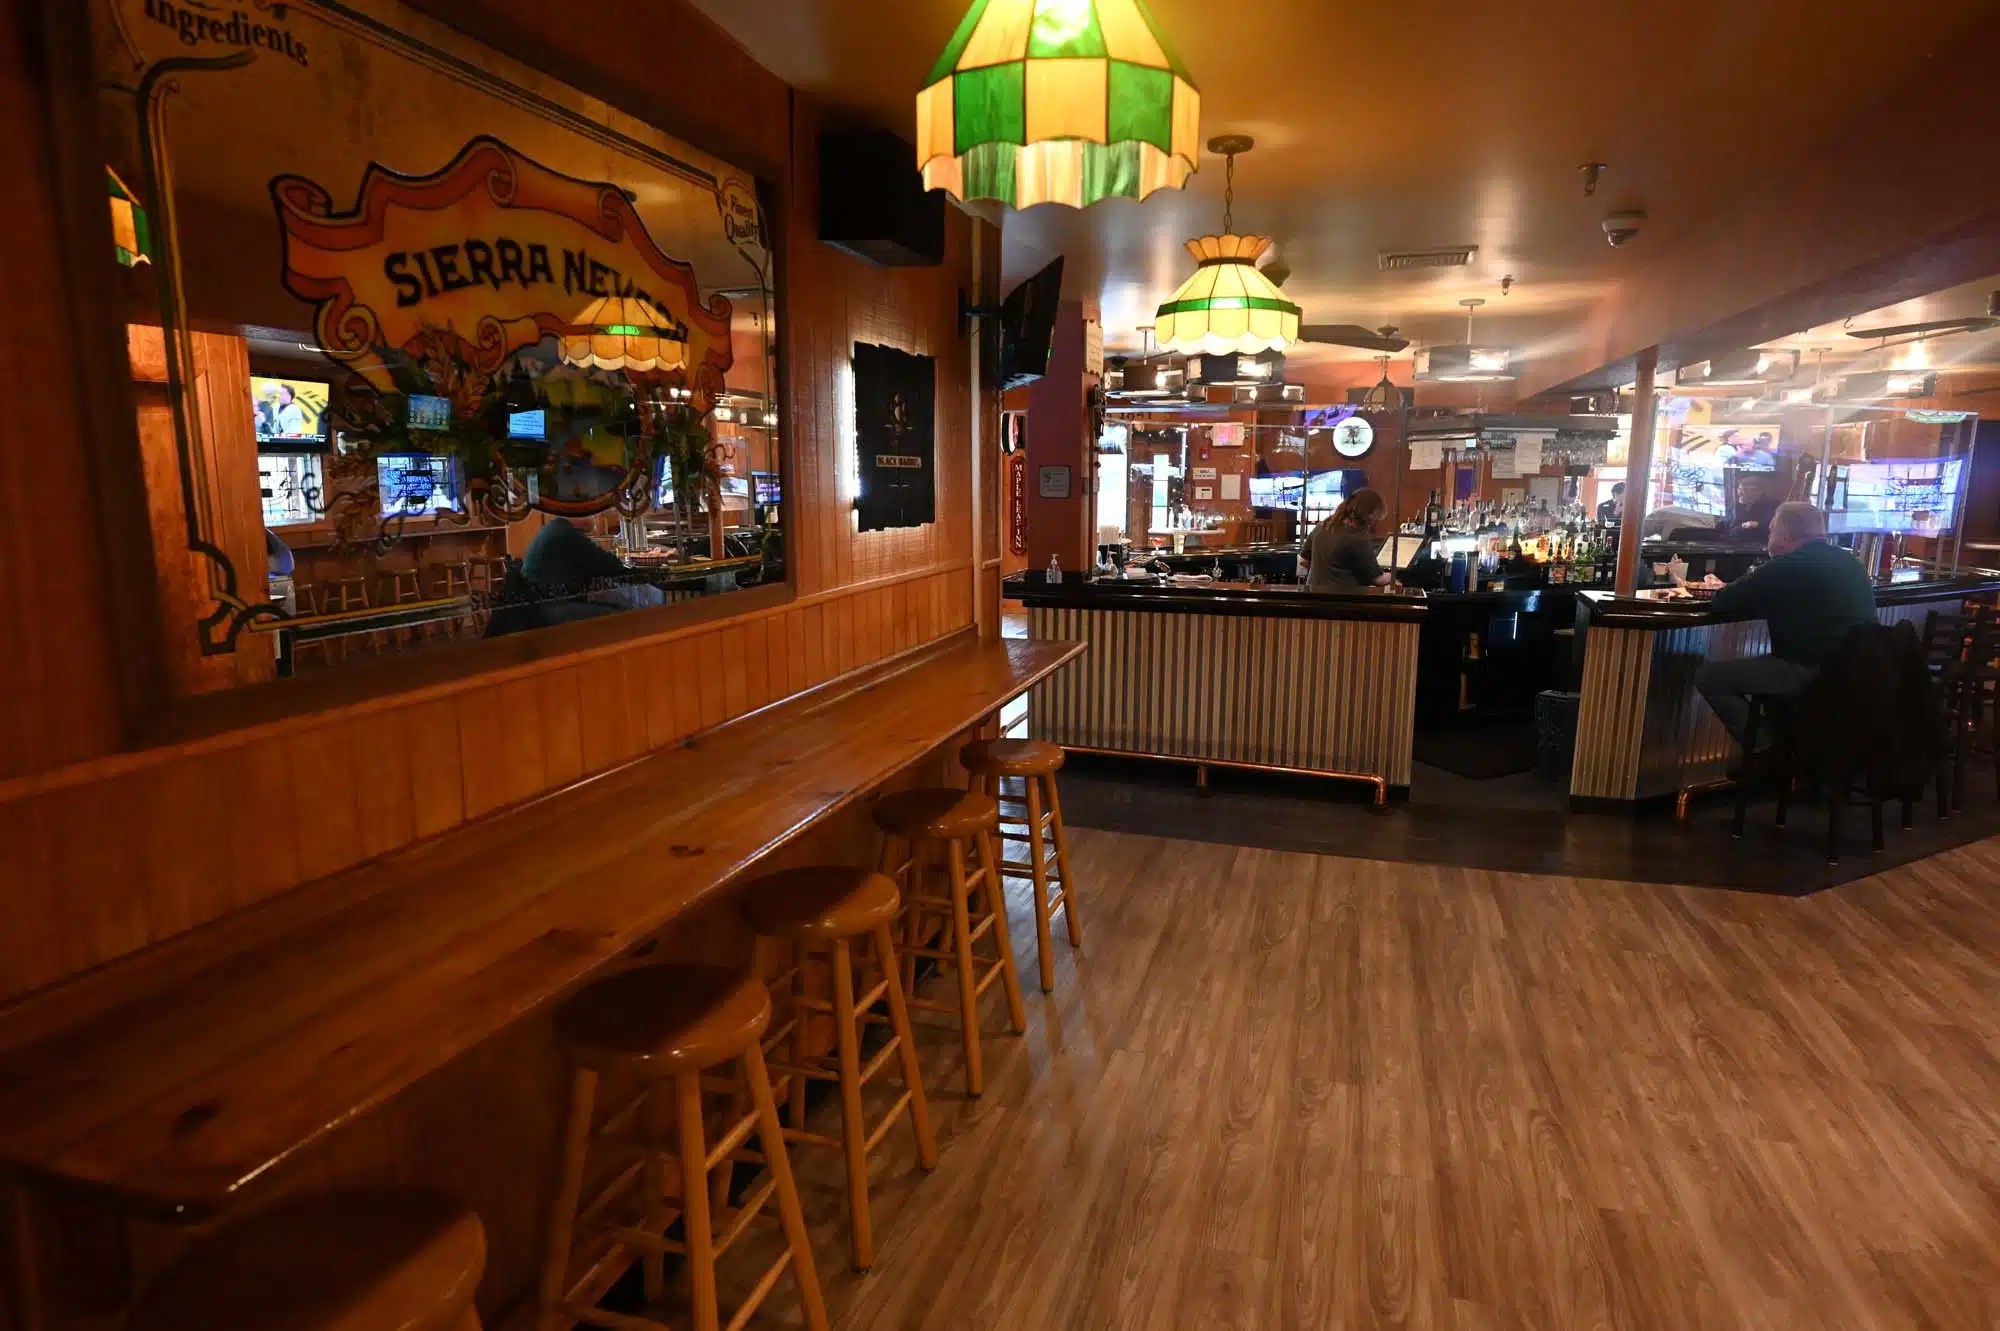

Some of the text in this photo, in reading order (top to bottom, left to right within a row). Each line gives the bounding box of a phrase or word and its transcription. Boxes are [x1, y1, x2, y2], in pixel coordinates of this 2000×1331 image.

[384, 236, 688, 344] SIERRA NEV
[1014, 464, 1023, 497] MAPLE
[1014, 528, 1022, 548] INN
